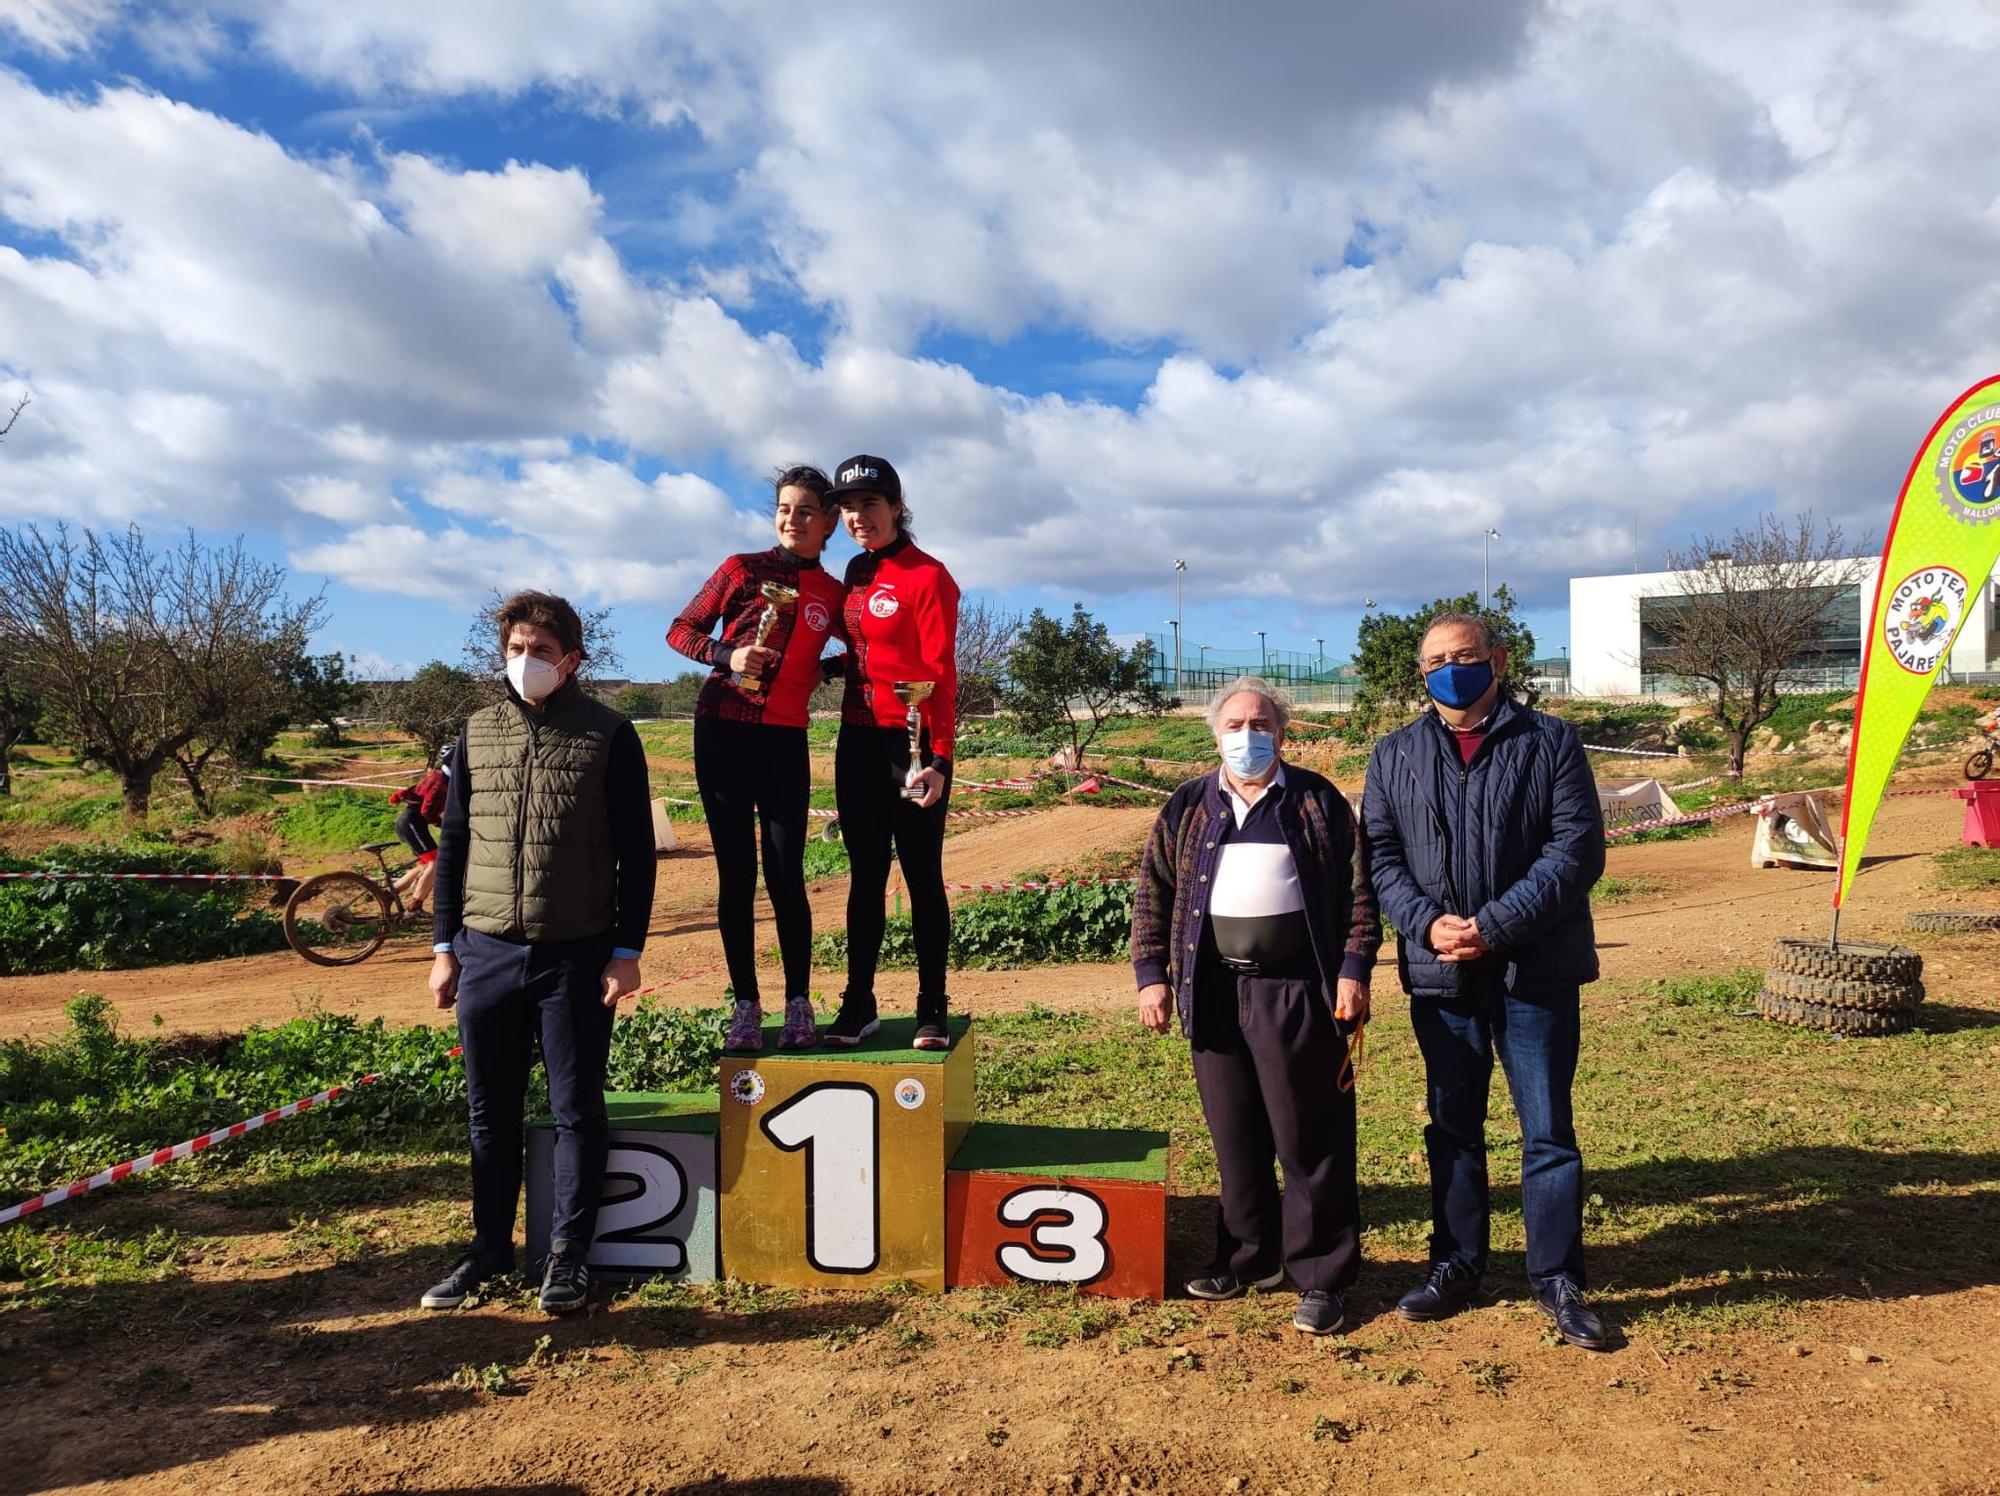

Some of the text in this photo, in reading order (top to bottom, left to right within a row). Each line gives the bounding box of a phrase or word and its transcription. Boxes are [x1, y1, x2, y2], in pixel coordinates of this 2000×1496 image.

[841, 464, 879, 484] rplus
[1939, 428, 1967, 468] MOTO
[1891, 572, 1935, 612] MOTO
[588, 1141, 688, 1274] 2
[760, 1081, 882, 1275] 1
[995, 1185, 1110, 1287] 3
